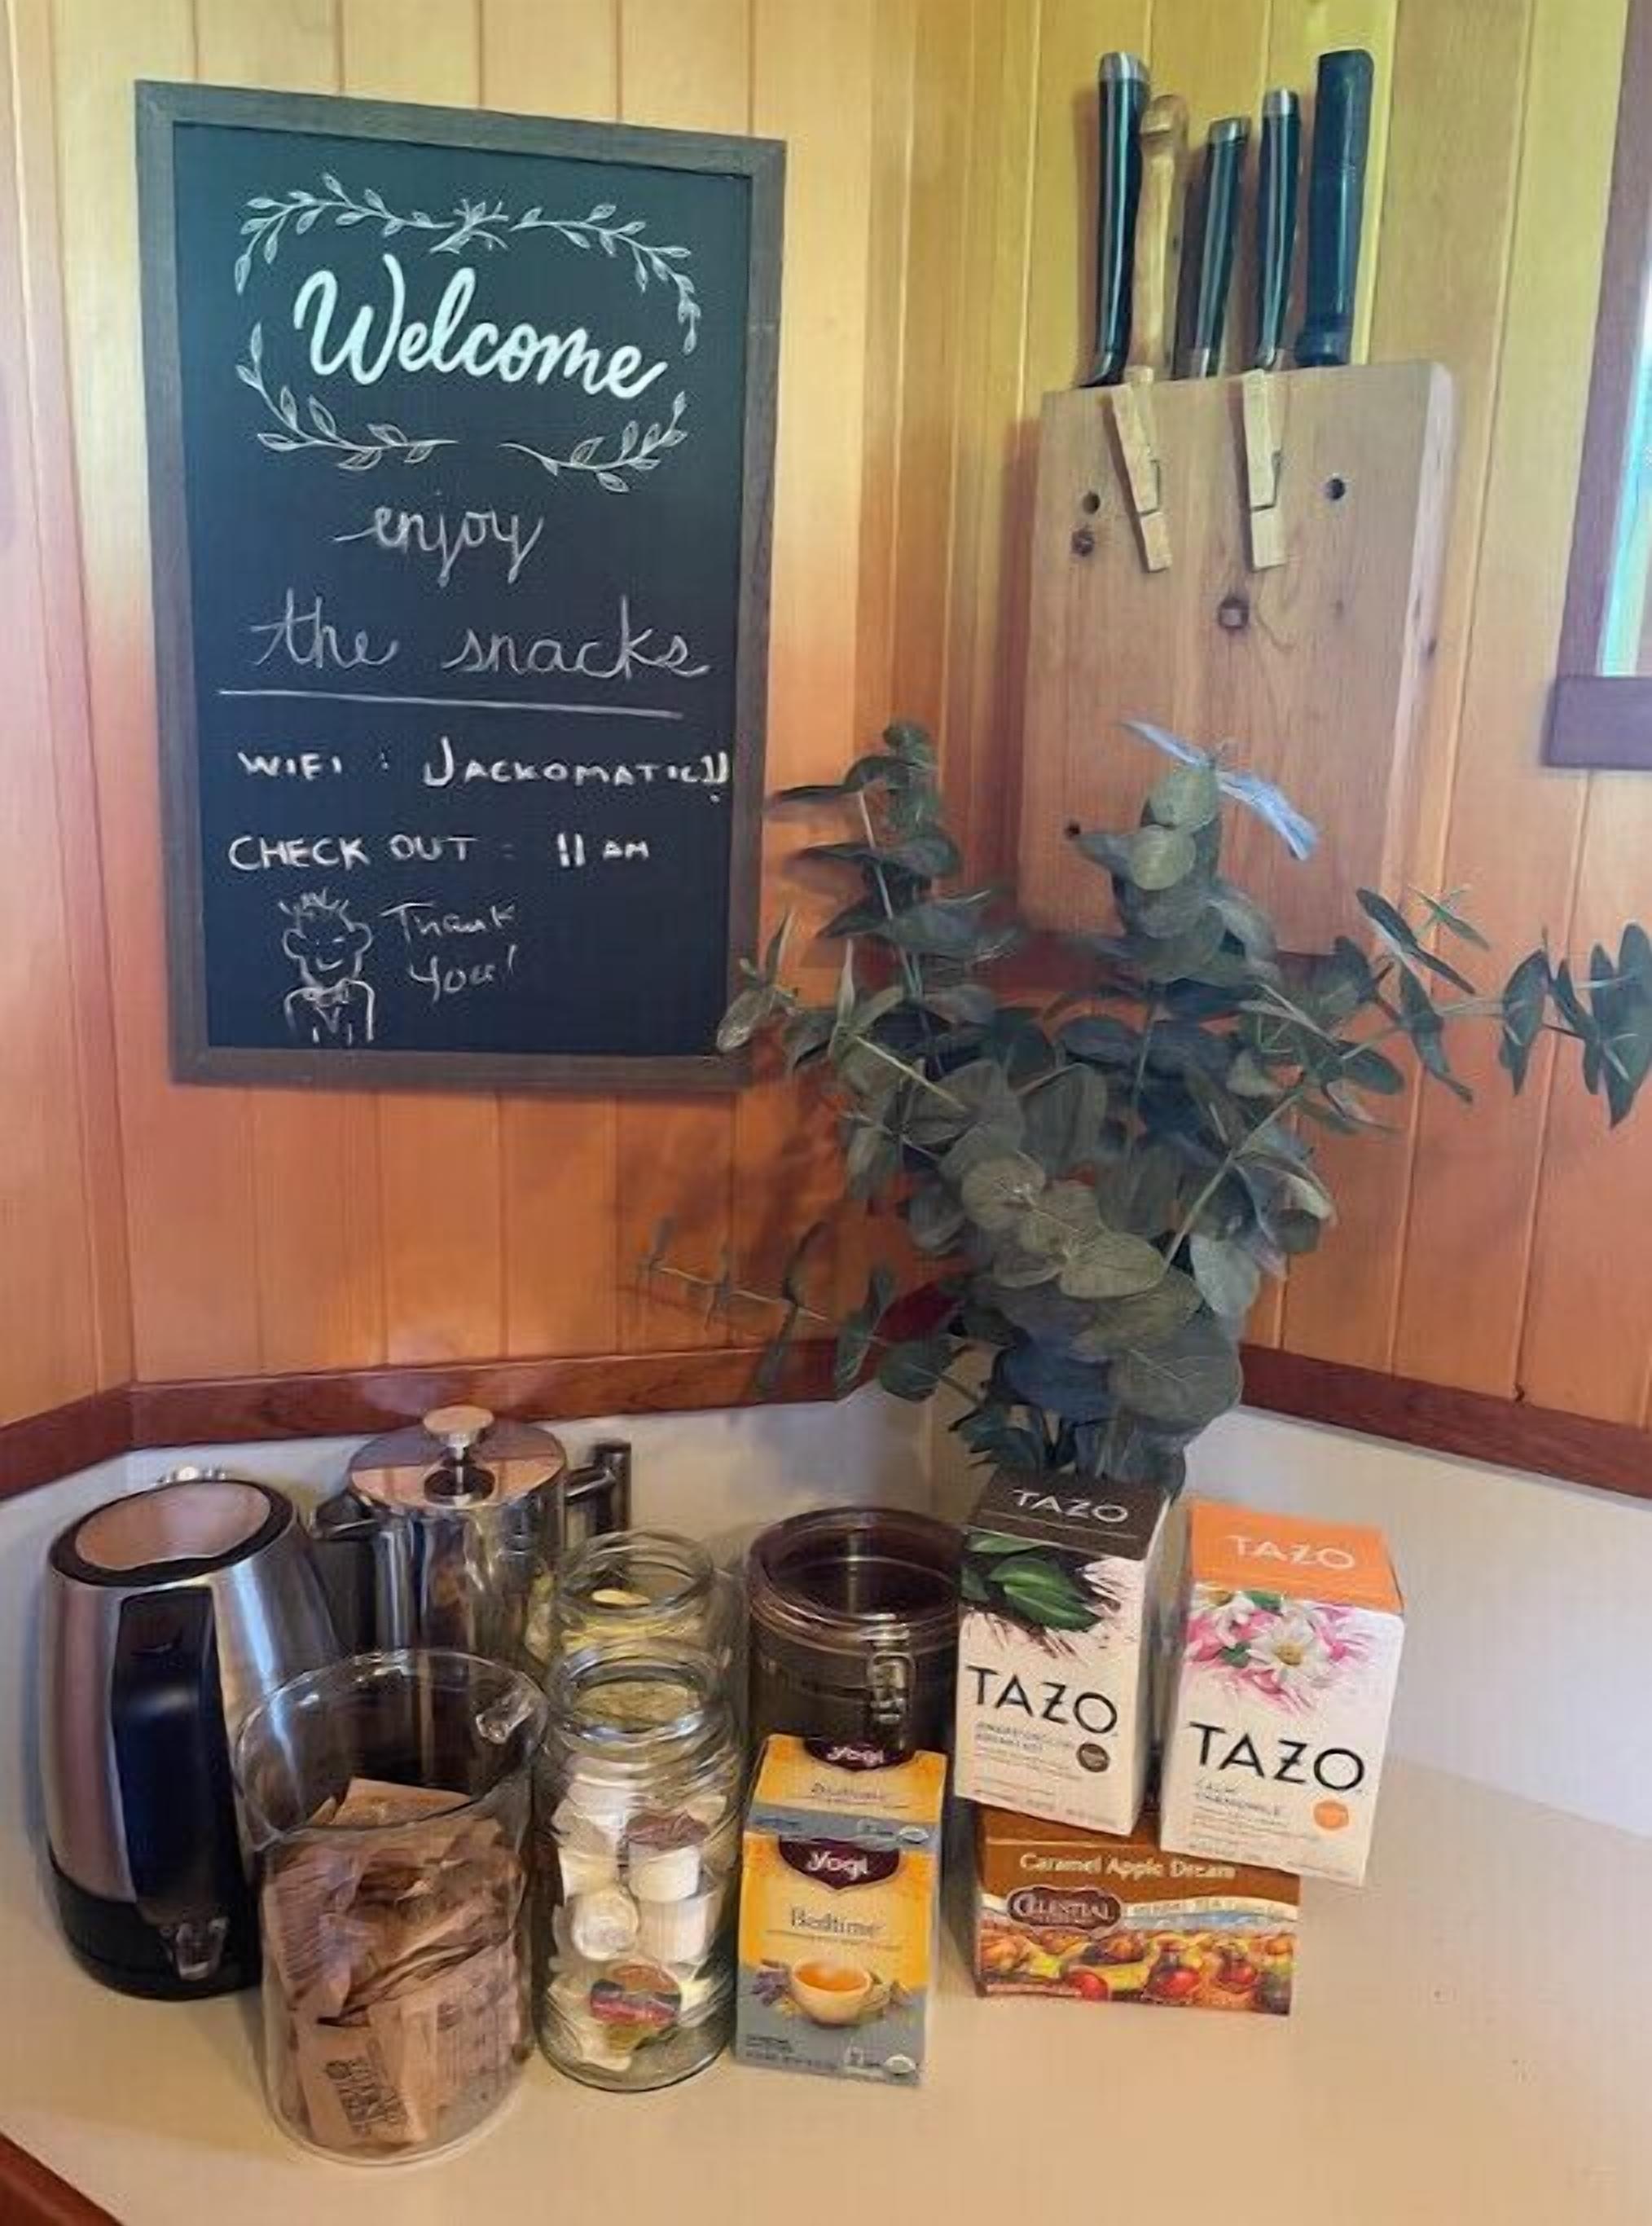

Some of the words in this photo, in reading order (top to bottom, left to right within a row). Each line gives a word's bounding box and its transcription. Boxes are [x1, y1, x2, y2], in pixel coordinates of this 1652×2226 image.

[293, 253, 668, 399] Welcome
[332, 500, 545, 587] enjoy
[250, 587, 401, 670] the
[442, 595, 711, 680] snacks
[227, 835, 371, 871] CHECK
[389, 833, 482, 861] OUT
[1012, 1489, 1130, 1524] TAZO
[1225, 1534, 1358, 1570] TAZO
[964, 1665, 1118, 1735] TAZO
[1189, 1721, 1365, 1792] TAZO
